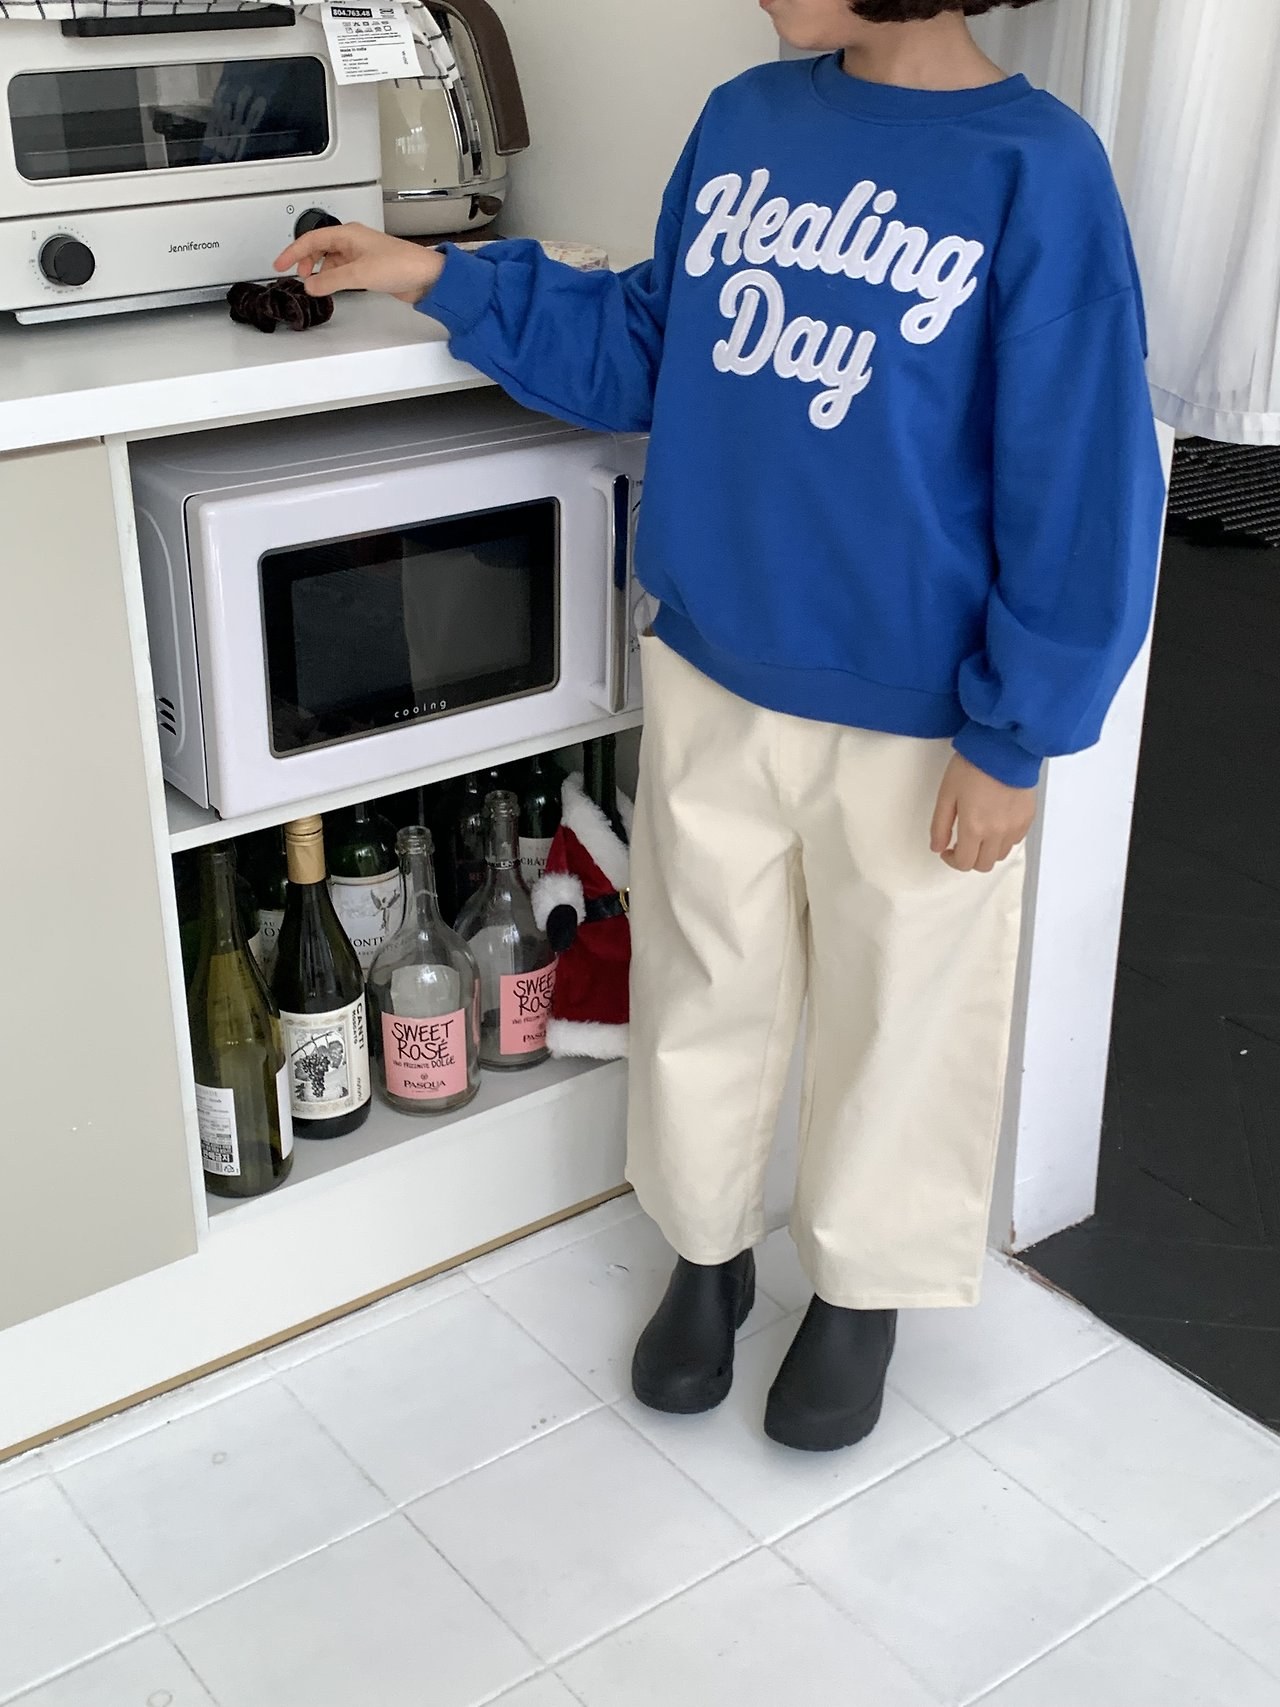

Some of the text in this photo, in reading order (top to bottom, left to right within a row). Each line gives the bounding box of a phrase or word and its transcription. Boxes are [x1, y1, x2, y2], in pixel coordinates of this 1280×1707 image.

[332, 8, 371, 17] 804.763.48
[168, 241, 220, 253] Jenniferoom
[685, 168, 985, 345] Healing
[712, 268, 876, 430] Day
[394, 700, 447, 719] cooing
[512, 968, 555, 997] SWEE
[518, 988, 553, 1016] ROS
[356, 1002, 365, 1050] CANTI
[391, 1019, 454, 1042] SWEET
[398, 1039, 450, 1061] ROSÉ
[403, 1080, 447, 1090] PASQUA
